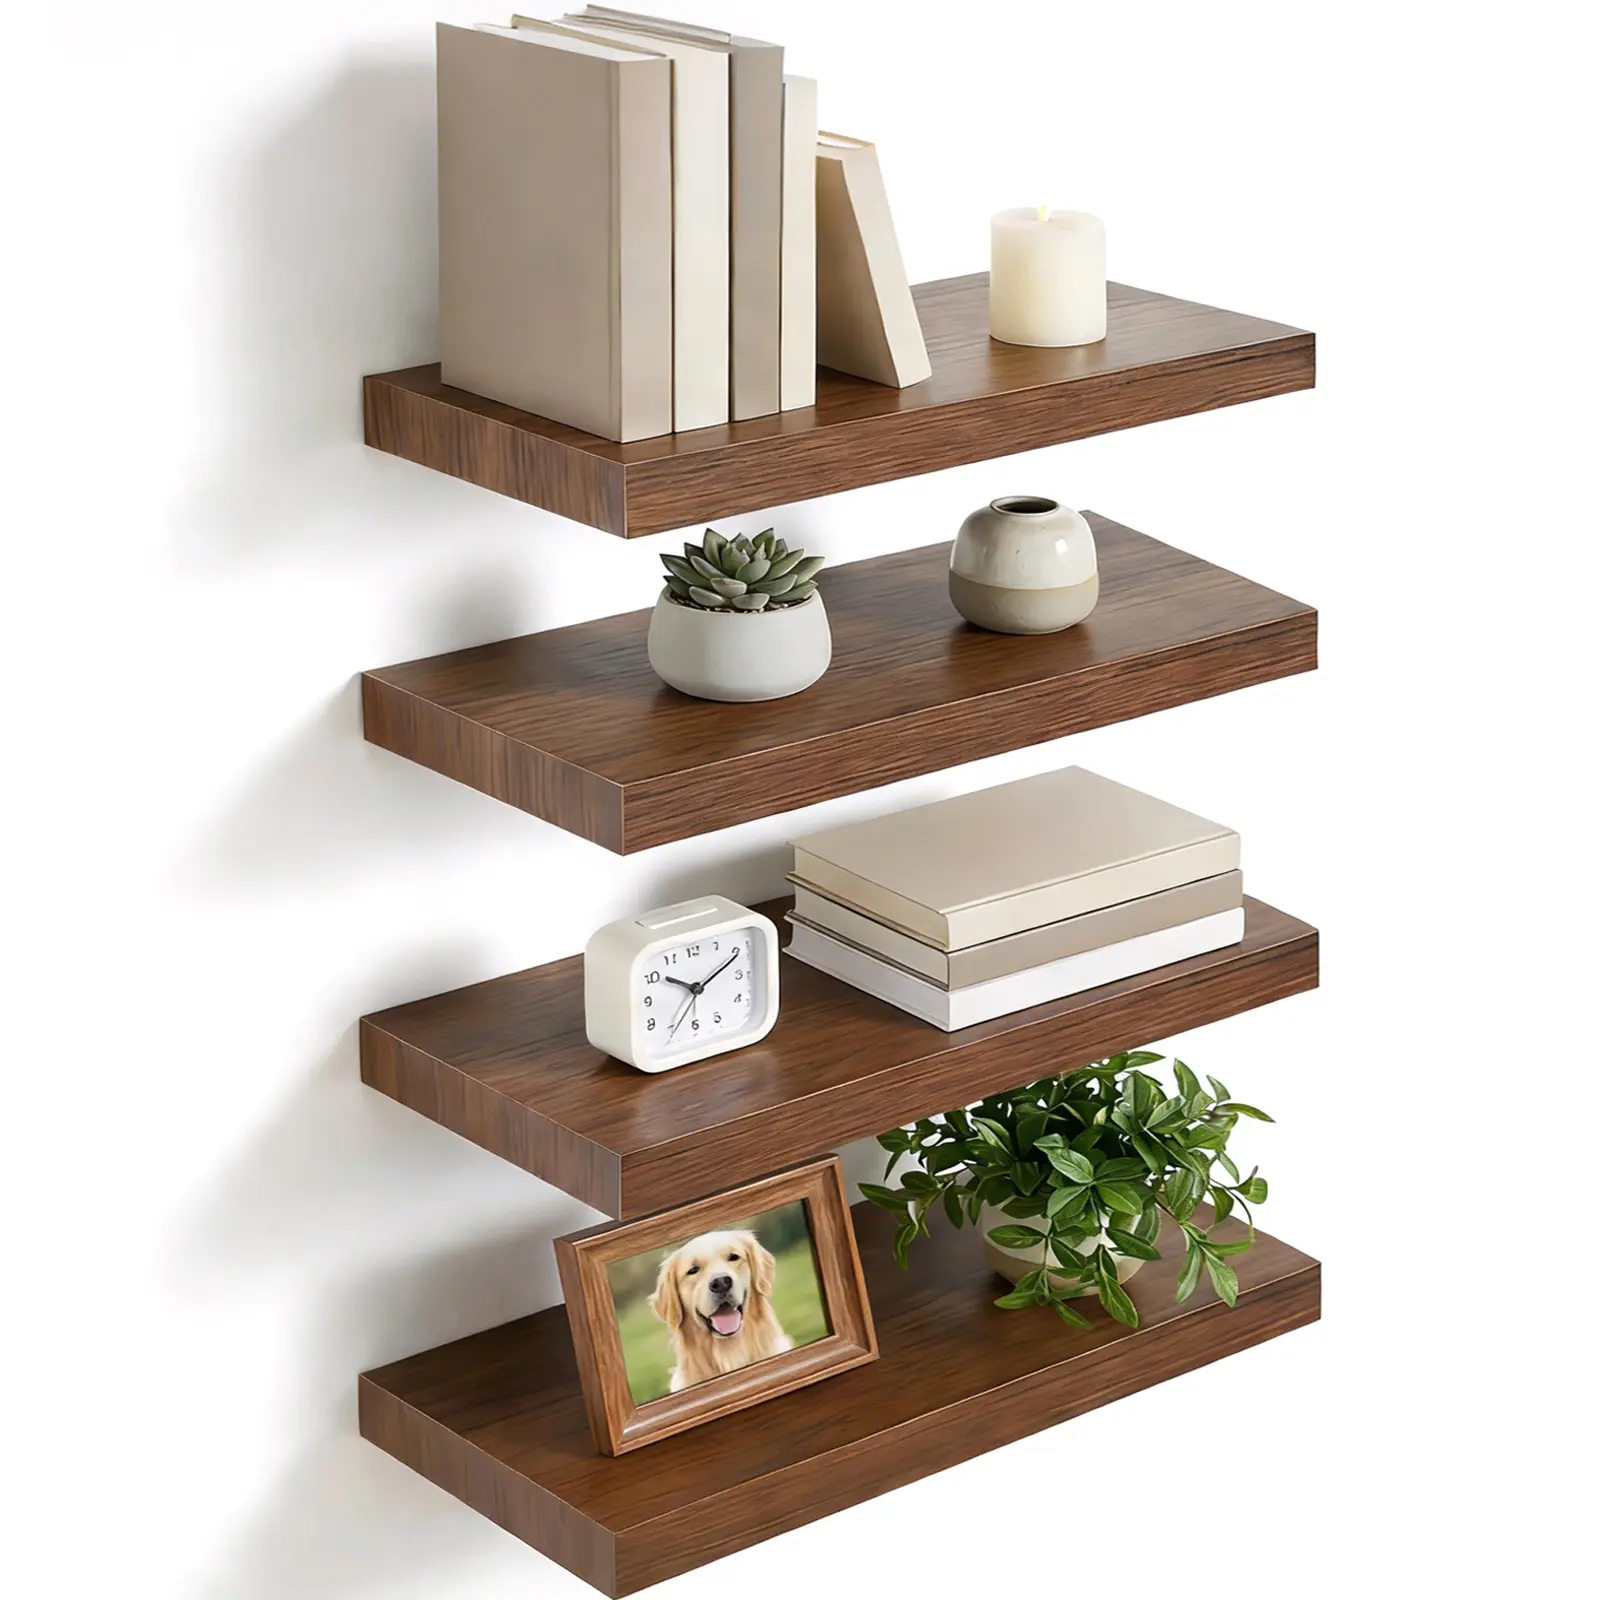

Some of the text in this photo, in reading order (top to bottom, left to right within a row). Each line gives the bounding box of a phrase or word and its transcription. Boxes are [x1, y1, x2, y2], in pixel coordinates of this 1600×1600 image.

[643, 970, 660, 985] 10
[643, 995, 653, 1007] 9
[646, 1017, 656, 1031] 8
[690, 1019, 700, 1031] 6
